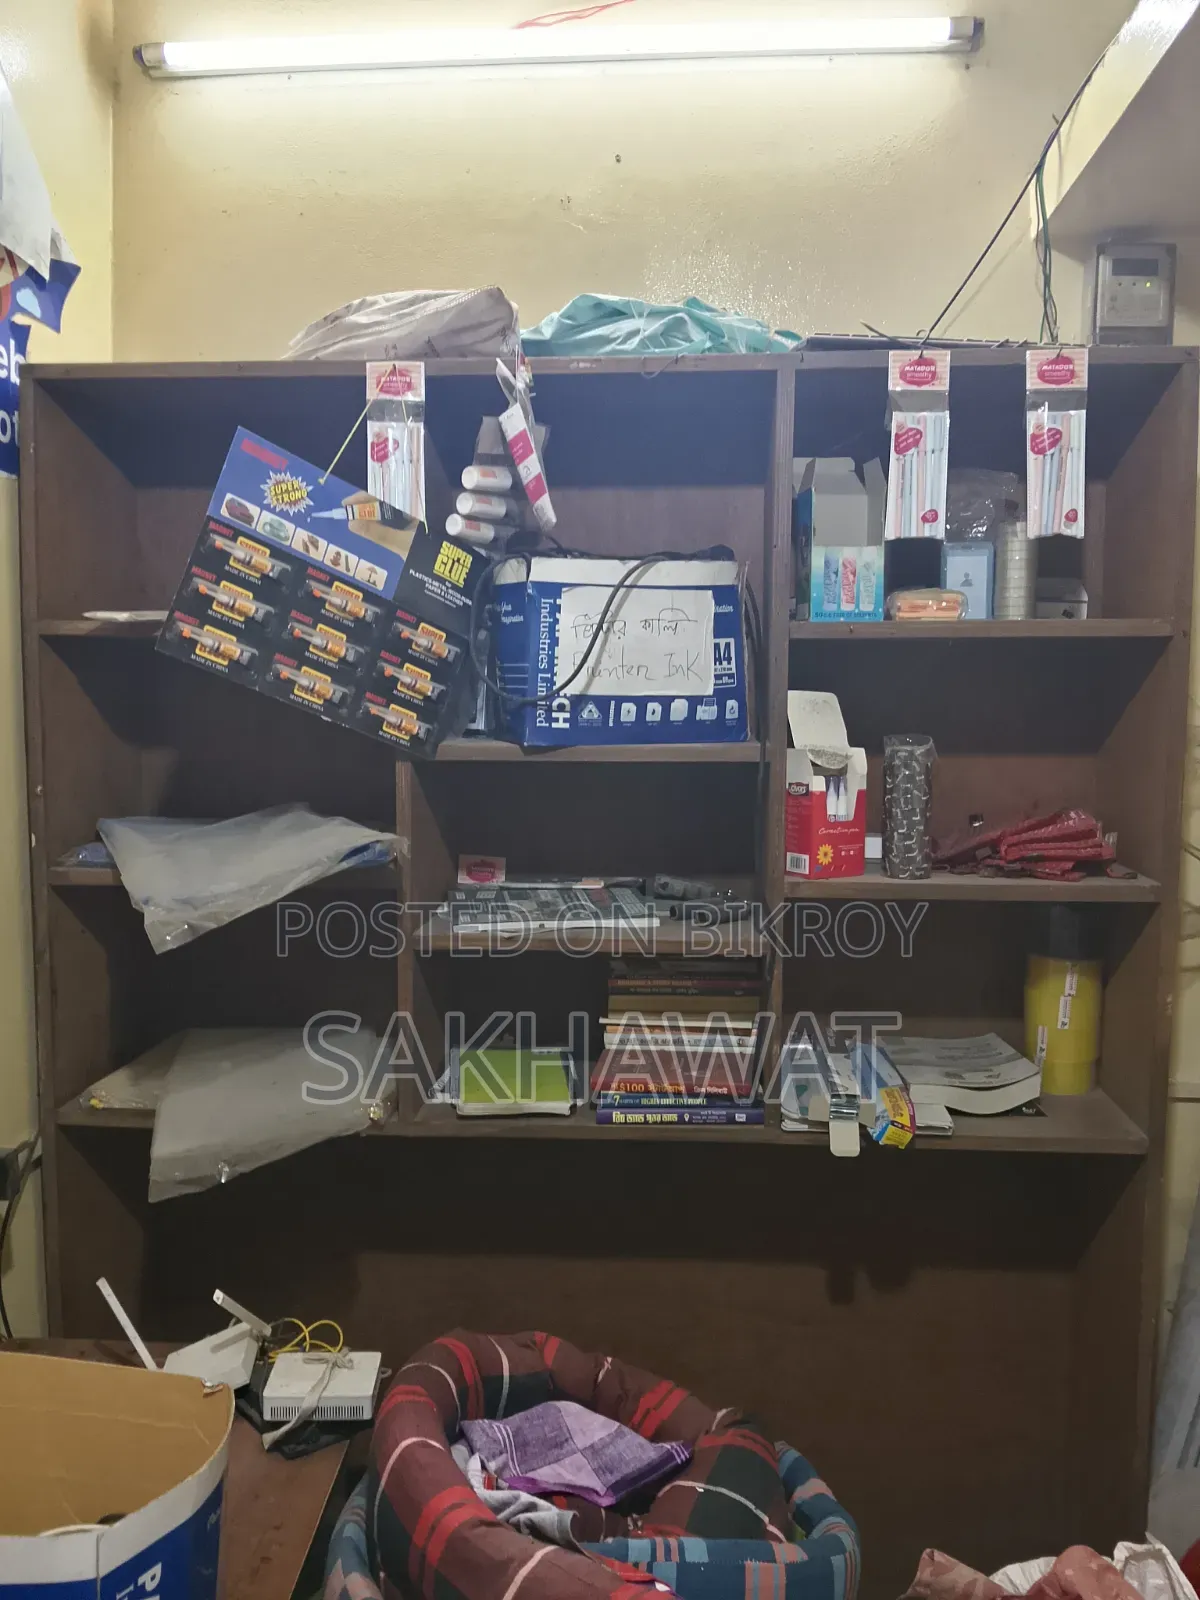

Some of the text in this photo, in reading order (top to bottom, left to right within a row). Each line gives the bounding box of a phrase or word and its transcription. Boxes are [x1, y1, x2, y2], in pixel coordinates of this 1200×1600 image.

[270, 479, 300, 496] SUPER
[272, 488, 308, 506] STRONG
[440, 540, 472, 568] SUPER
[434, 553, 469, 587] GLUE
[538, 598, 554, 669] Industries
[714, 641, 732, 666] A4
[536, 673, 551, 728] Limited
[613, 1095, 620, 1106] 7
[620, 1083, 645, 1093] $100
